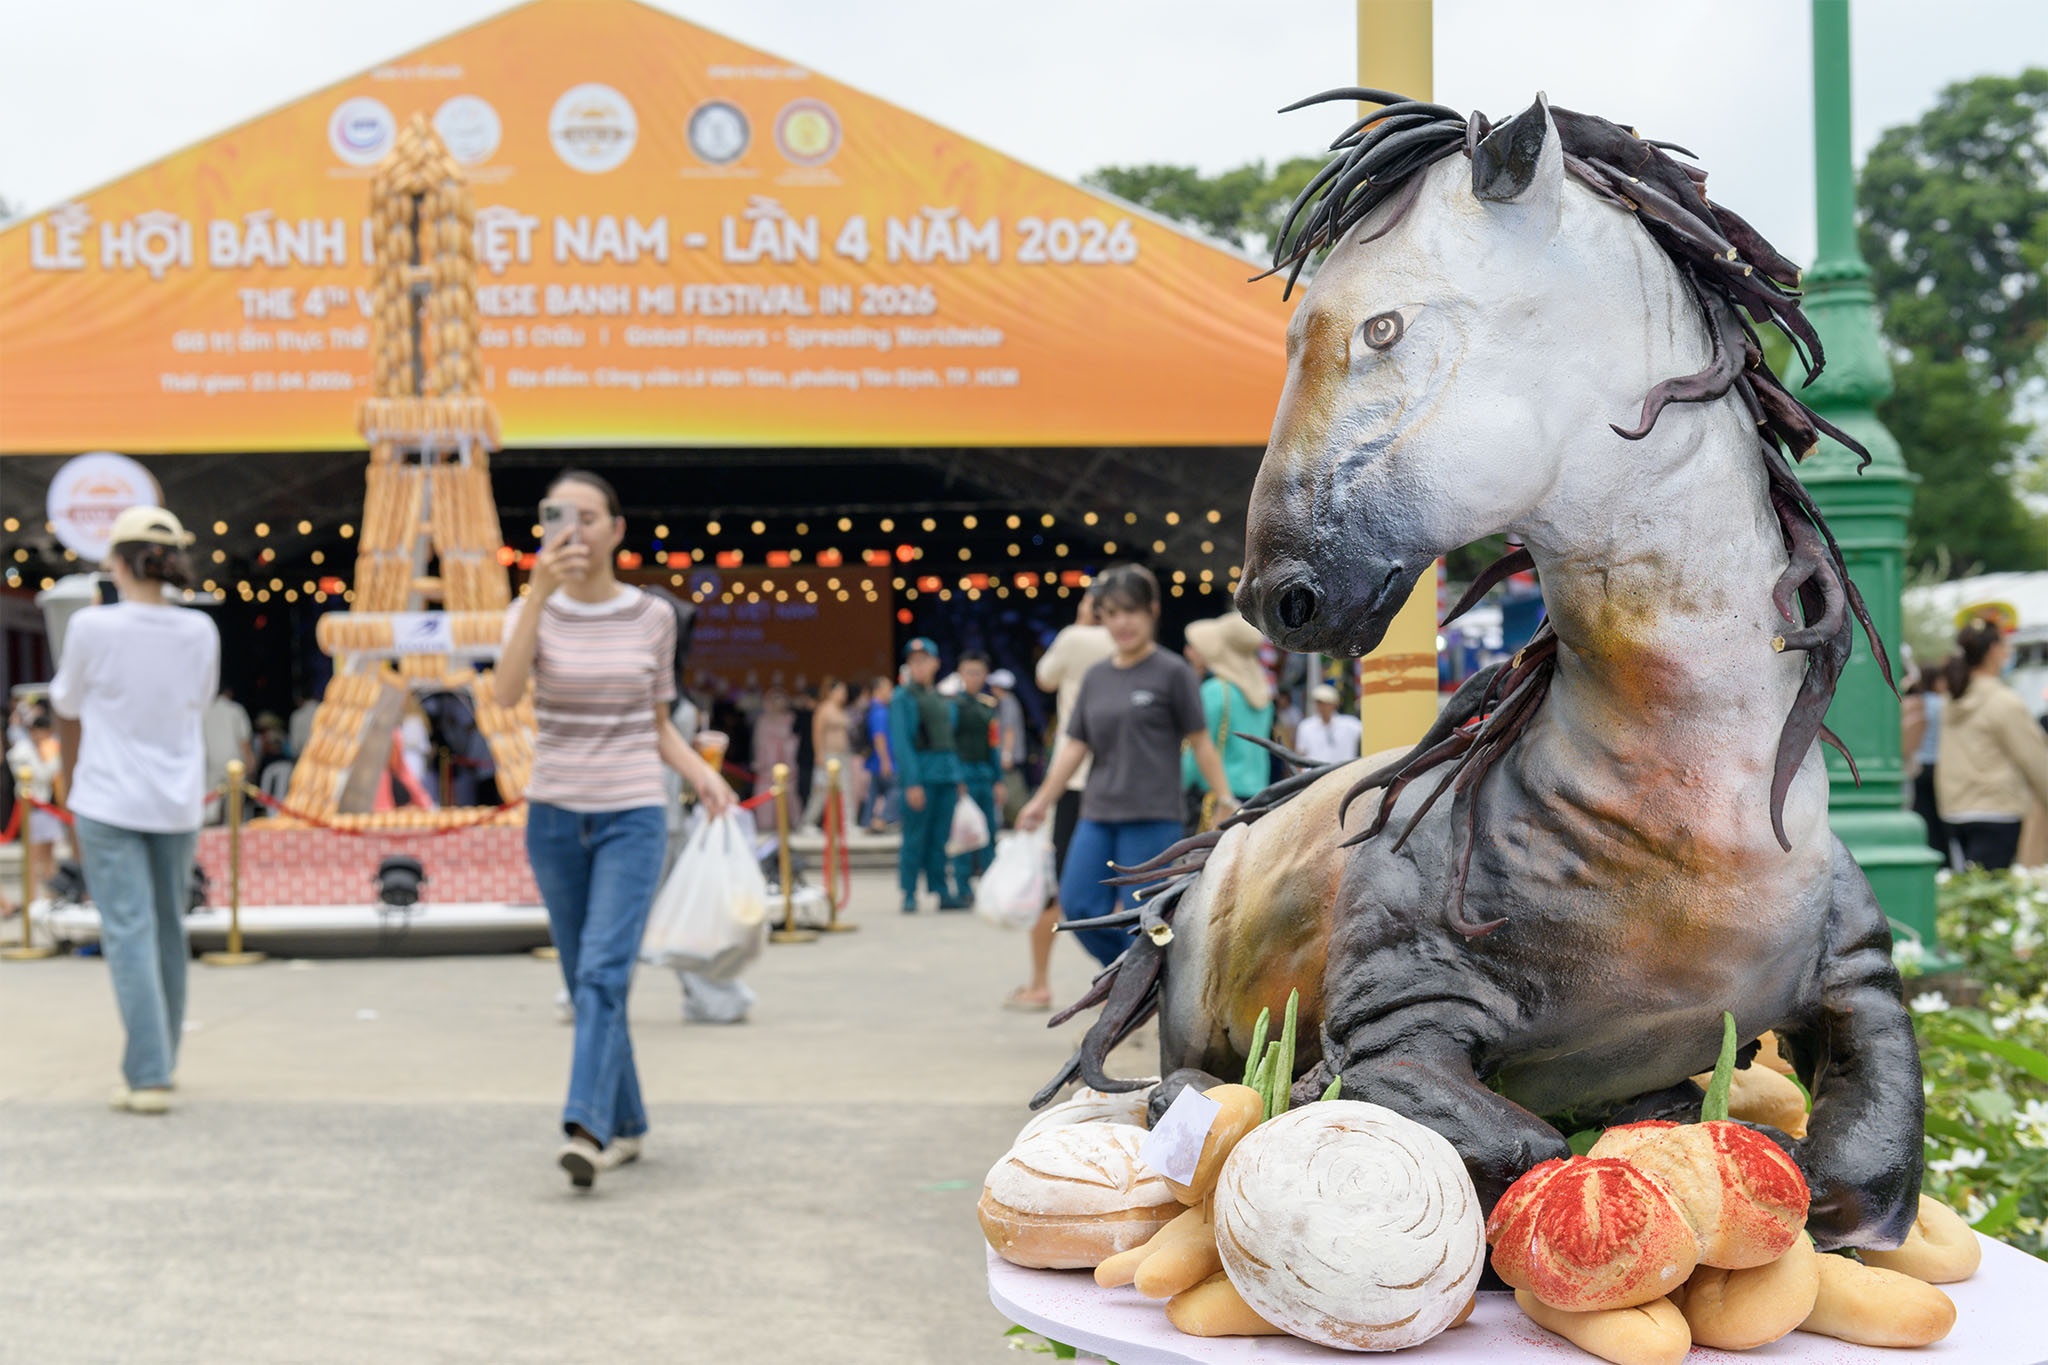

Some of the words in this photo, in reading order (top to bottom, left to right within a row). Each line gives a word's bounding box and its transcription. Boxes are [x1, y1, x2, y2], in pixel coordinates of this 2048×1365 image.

[31, 202, 91, 269] LỄ
[101, 210, 192, 277] HỘI
[209, 209, 346, 266] BÁNH
[554, 216, 668, 261] NAM
[723, 195, 819, 262] LẦN
[836, 216, 870, 261] 4
[887, 207, 1000, 262] NĂM
[1018, 216, 1137, 263] 2026
[239, 288, 295, 319] THE
[545, 284, 630, 314] BANH
[638, 285, 675, 313] MI
[682, 284, 812, 315] FESTIVAL
[820, 285, 852, 314] IN
[861, 284, 936, 314] 2026
